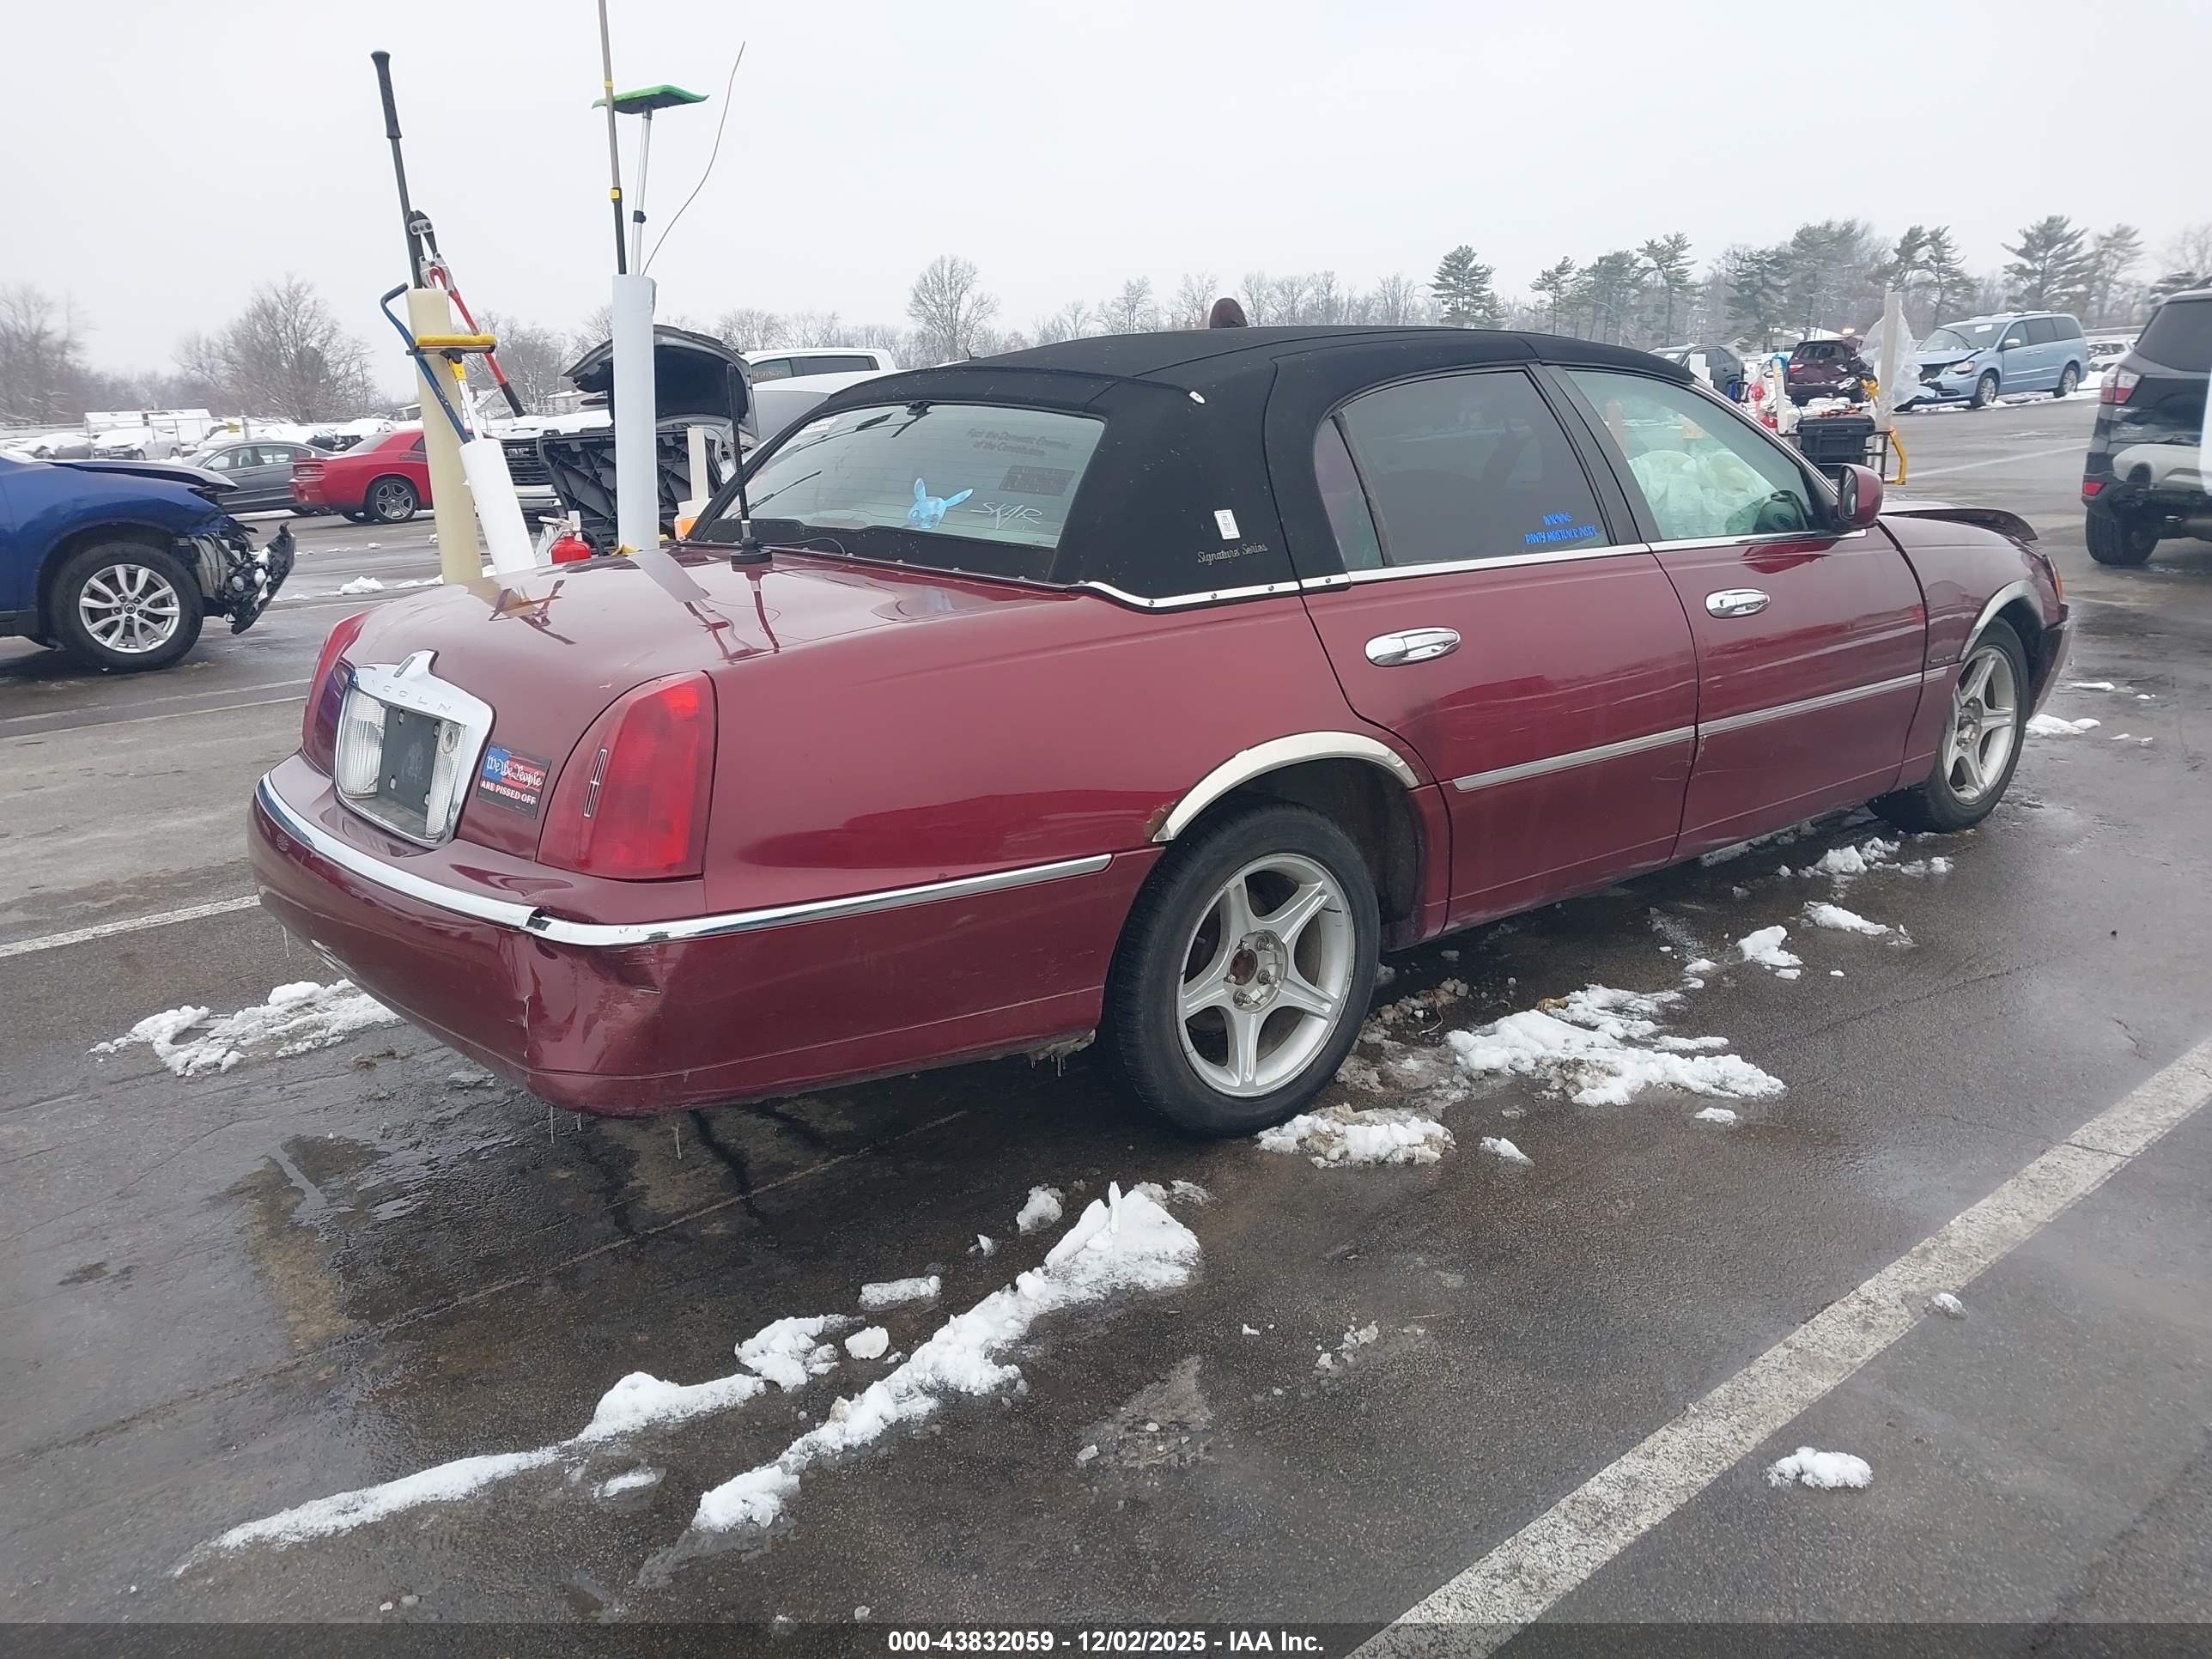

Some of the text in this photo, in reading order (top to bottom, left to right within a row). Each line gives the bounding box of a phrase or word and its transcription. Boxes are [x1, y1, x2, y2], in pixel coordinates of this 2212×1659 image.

[970, 501, 1043, 530] SKAR
[1197, 542, 1268, 566] Signature Series
[513, 763, 544, 790] People
[480, 780, 537, 805] ARE PISSED OFF
